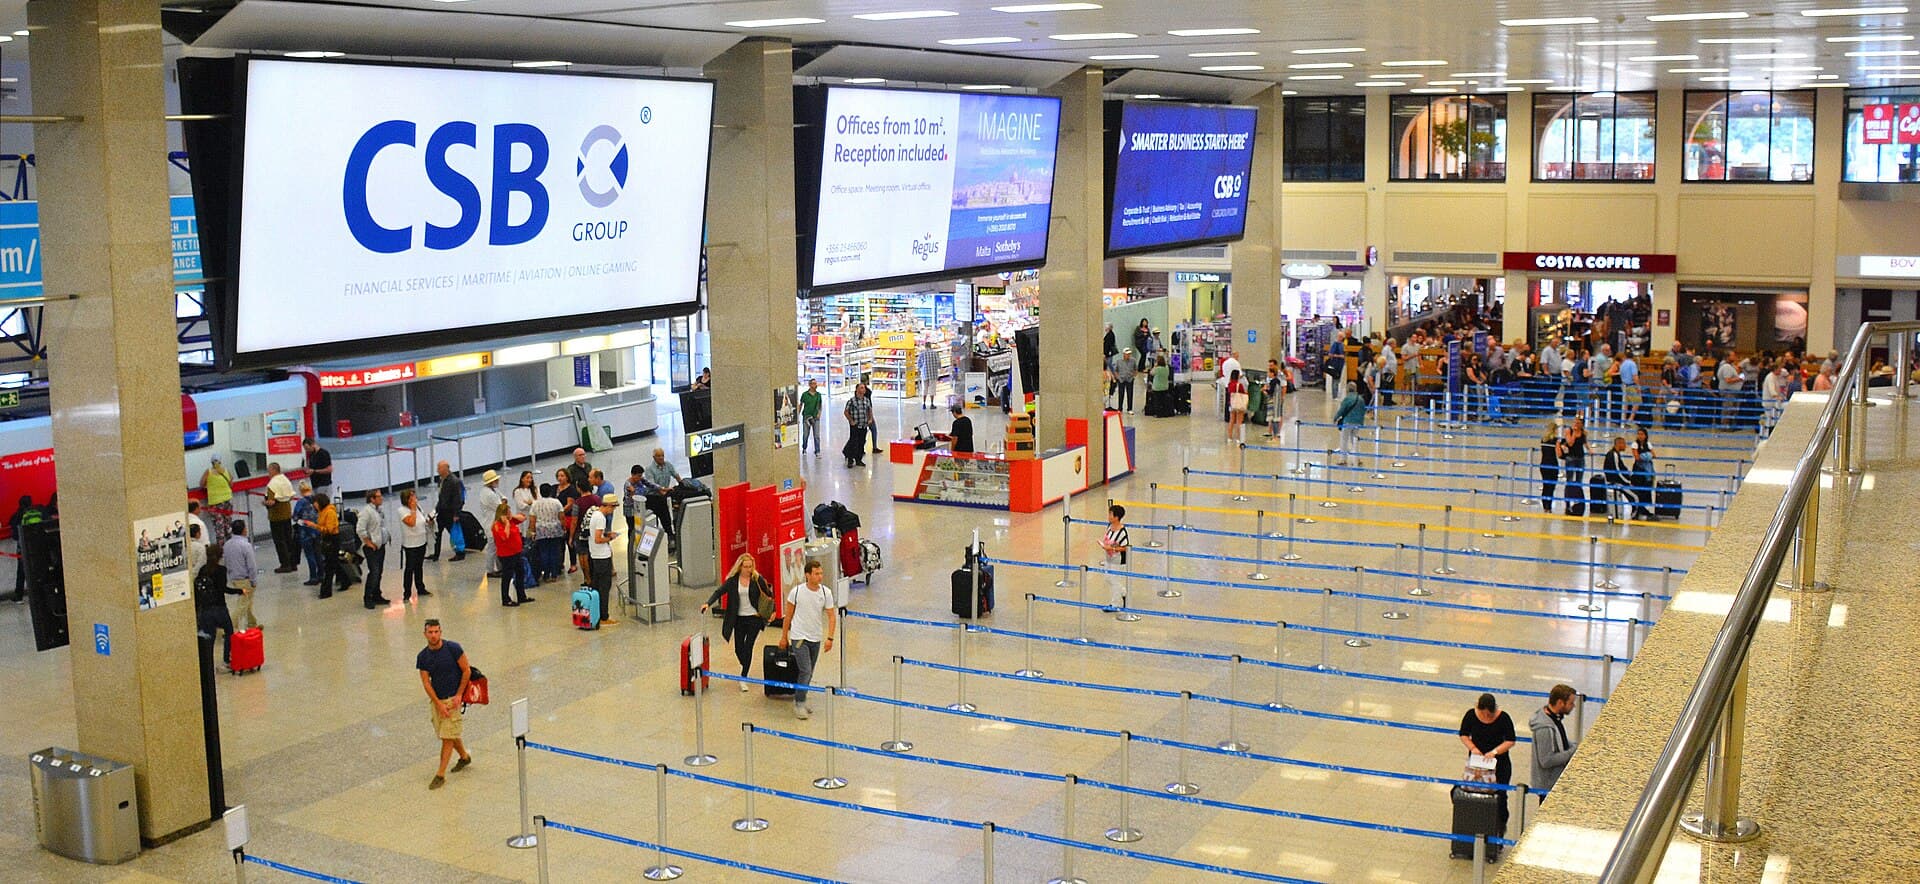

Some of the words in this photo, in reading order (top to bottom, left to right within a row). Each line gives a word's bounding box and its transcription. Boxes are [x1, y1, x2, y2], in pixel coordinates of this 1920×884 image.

[836, 114, 880, 135] Offices
[883, 115, 911, 136] from
[914, 117, 927, 136] 10
[978, 111, 1043, 141] IMAGINE
[1131, 132, 1169, 151] SMARTER
[1169, 133, 1204, 151] BUSINESS
[1204, 133, 1228, 151] STARTS
[834, 143, 896, 167] Reception
[897, 143, 948, 161] included.
[343, 119, 550, 254] CSB
[1213, 175, 1234, 199] CSB
[572, 220, 628, 242] GROUP
[912, 239, 939, 261] Regus
[1535, 255, 1583, 270] COSTA
[1585, 255, 1641, 270] COFFEE
[1890, 258, 1917, 268] BOV
[344, 281, 404, 297] FINANCIAL
[405, 275, 454, 292] SERVICES
[461, 270, 512, 287] MARITIME
[518, 266, 562, 282] AVIATION
[568, 263, 602, 278] ONLINE
[602, 260, 638, 275] GAMING
[141, 555, 183, 574] cancelled?
